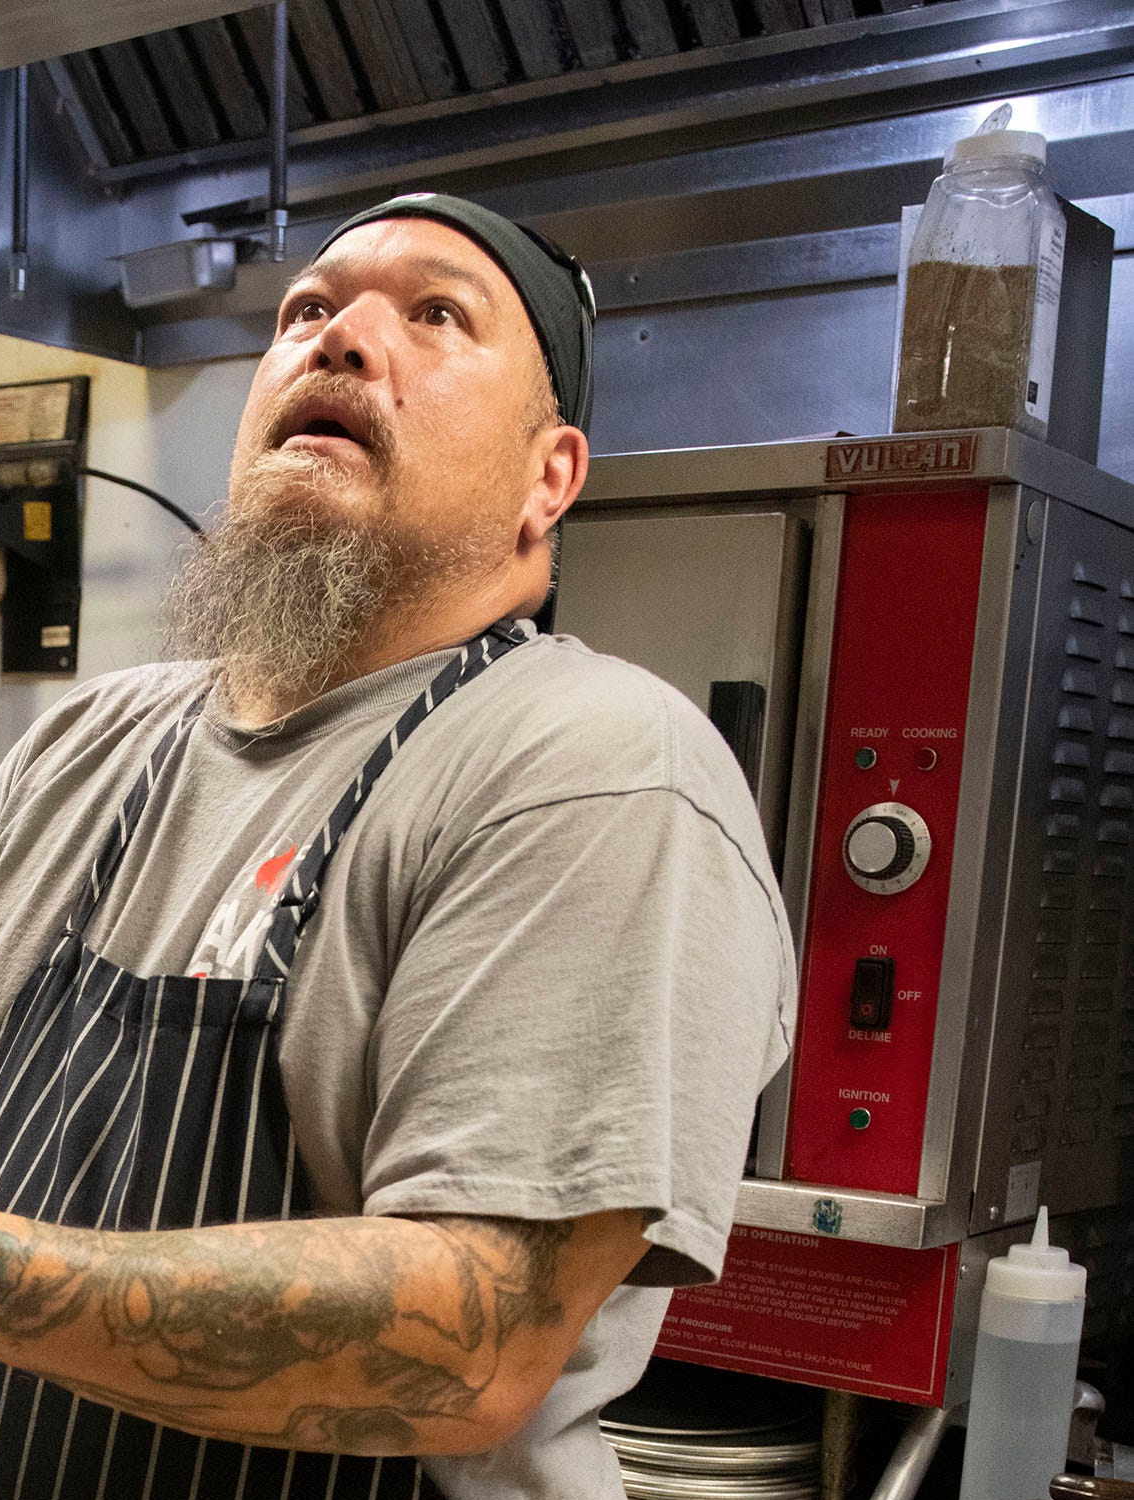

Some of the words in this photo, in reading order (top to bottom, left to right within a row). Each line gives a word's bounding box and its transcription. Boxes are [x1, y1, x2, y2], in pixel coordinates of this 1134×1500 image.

[850, 727, 889, 739] READY
[902, 727, 958, 740] COOKING
[869, 944, 888, 956] ON
[897, 990, 922, 1001] OFF
[848, 1029, 892, 1044] DELIME
[838, 1088, 890, 1103] IGNITION
[750, 1229, 820, 1249] OPERATION
[751, 1260, 766, 1270] THE
[780, 1280, 806, 1291] AFTER
[853, 1290, 876, 1302] WITH
[724, 1290, 738, 1300] ON
[753, 1294, 768, 1305] THE
[769, 1296, 787, 1308] GAS
[788, 1301, 821, 1314] SUPPLY
[749, 1283, 785, 1298] IGNITION
[786, 1289, 810, 1301] LIGHT
[811, 1293, 836, 1306] FAILS
[837, 1298, 848, 1308] TO
[850, 1301, 884, 1314] REMAIN
[885, 1306, 899, 1316] ON
[676, 1292, 688, 1301] OF
[689, 1293, 733, 1309] COMPLETE
[784, 1309, 826, 1326] REQUIRED
[826, 1317, 863, 1331] BEFORE
[680, 1317, 734, 1333] PROCEDURE
[683, 1330, 694, 1340] TO
[720, 1337, 747, 1350] CLOSE
[748, 1341, 783, 1357] MANUAL
[784, 1348, 803, 1360] GAS
